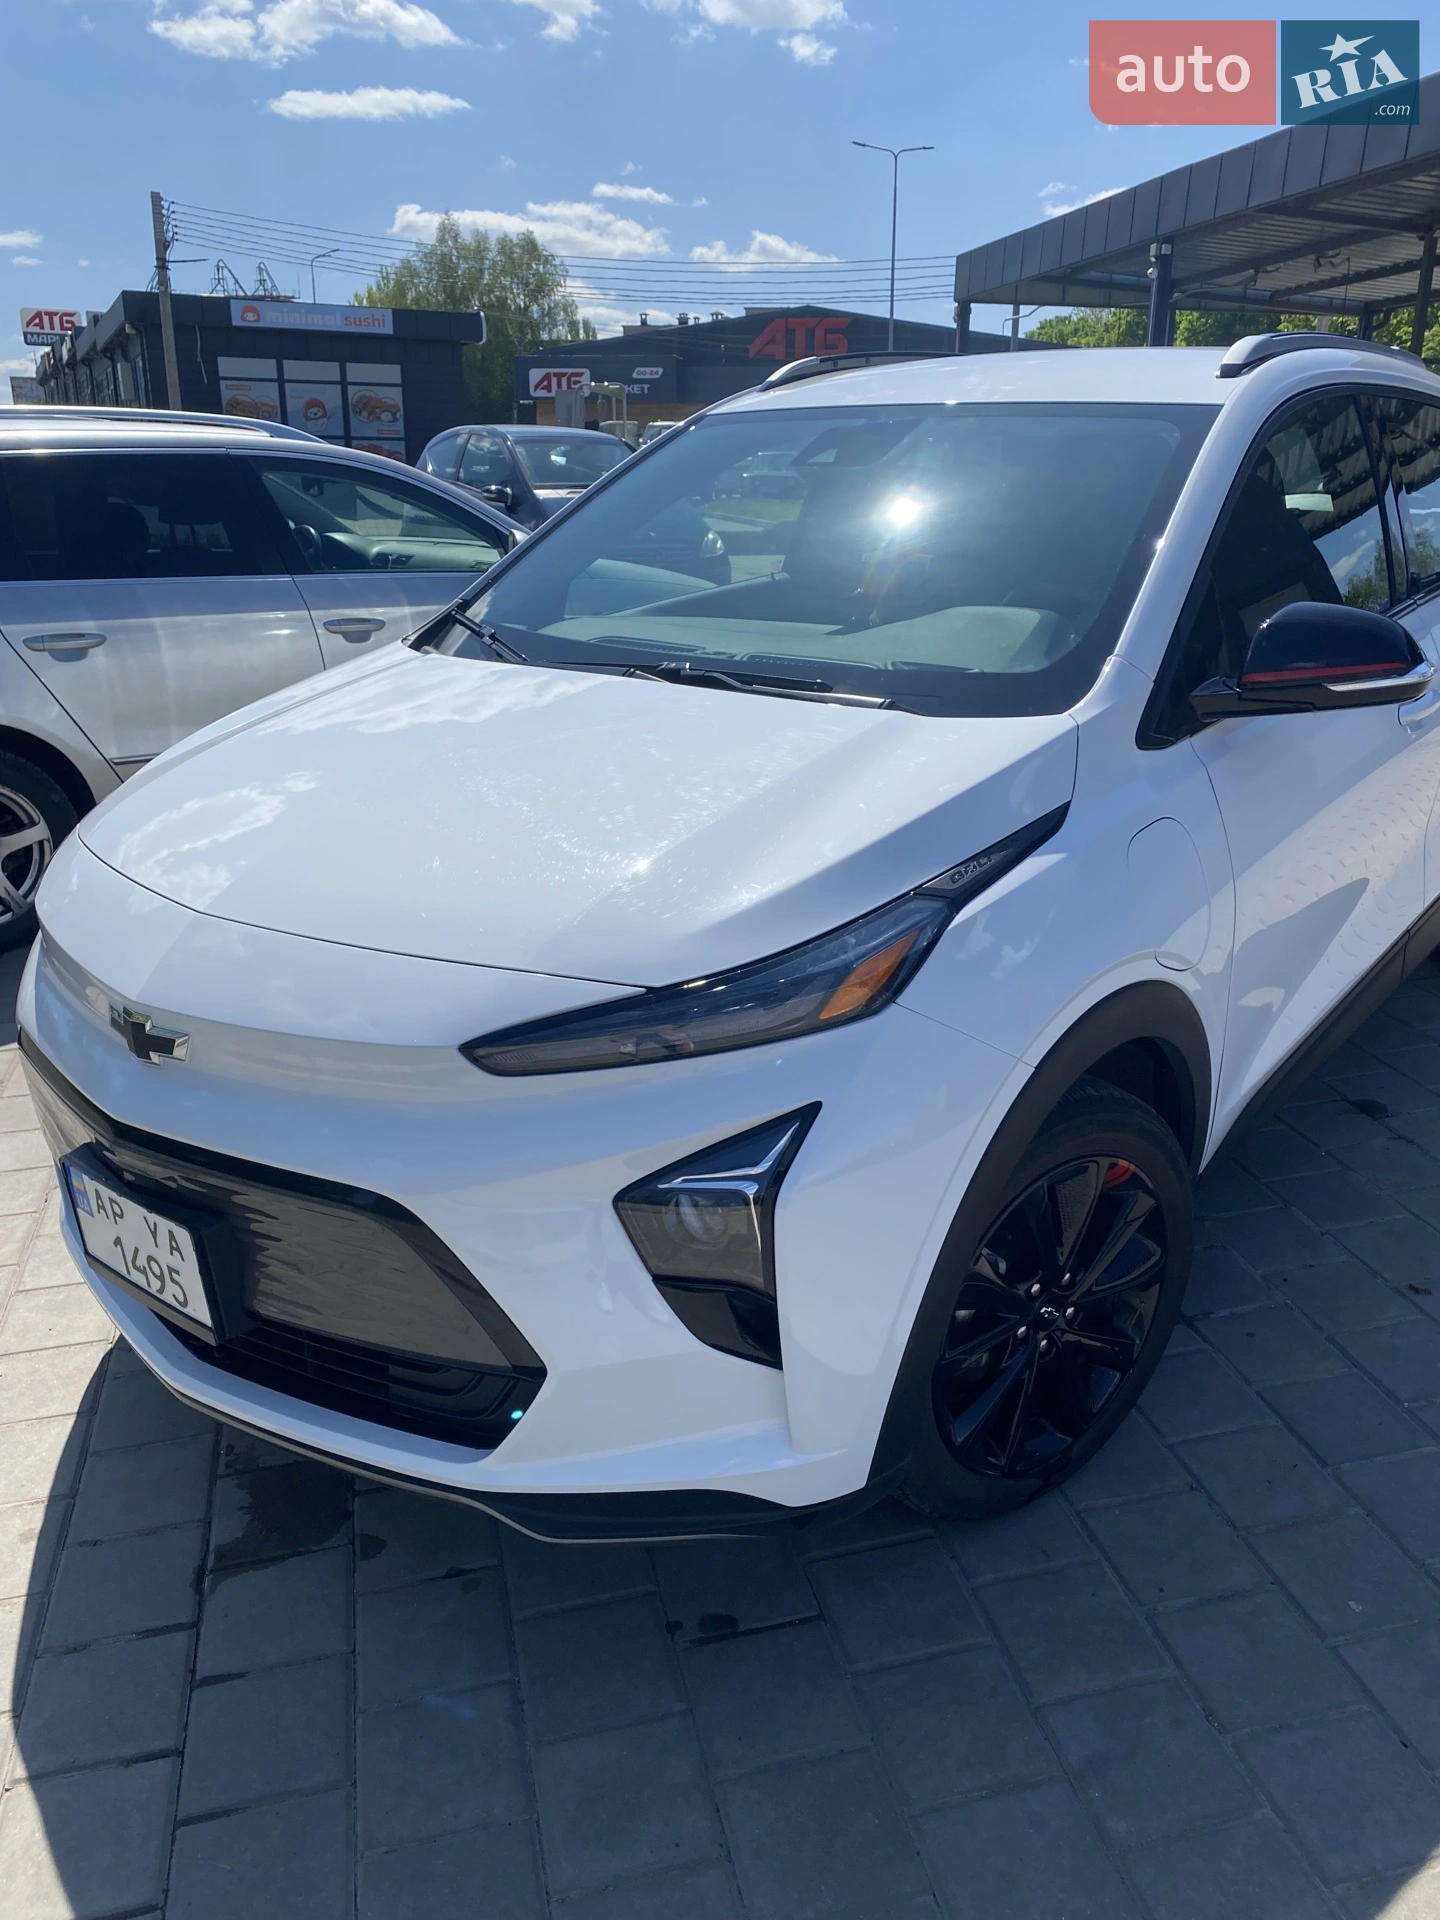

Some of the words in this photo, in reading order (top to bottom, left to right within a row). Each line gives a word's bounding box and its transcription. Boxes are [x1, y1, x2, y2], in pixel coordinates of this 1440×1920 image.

[25, 310, 77, 332] АТБ
[265, 308, 341, 327] minimal
[343, 313, 386, 329] sushi
[26, 333, 59, 345] МАР
[747, 316, 855, 361] АТБ
[533, 371, 586, 393] АТБ
[635, 369, 660, 377] 00-24
[75, 1193, 92, 1213] UA
[94, 1188, 125, 1225] AP
[143, 1215, 185, 1263] YA
[112, 1235, 188, 1309] 1495
